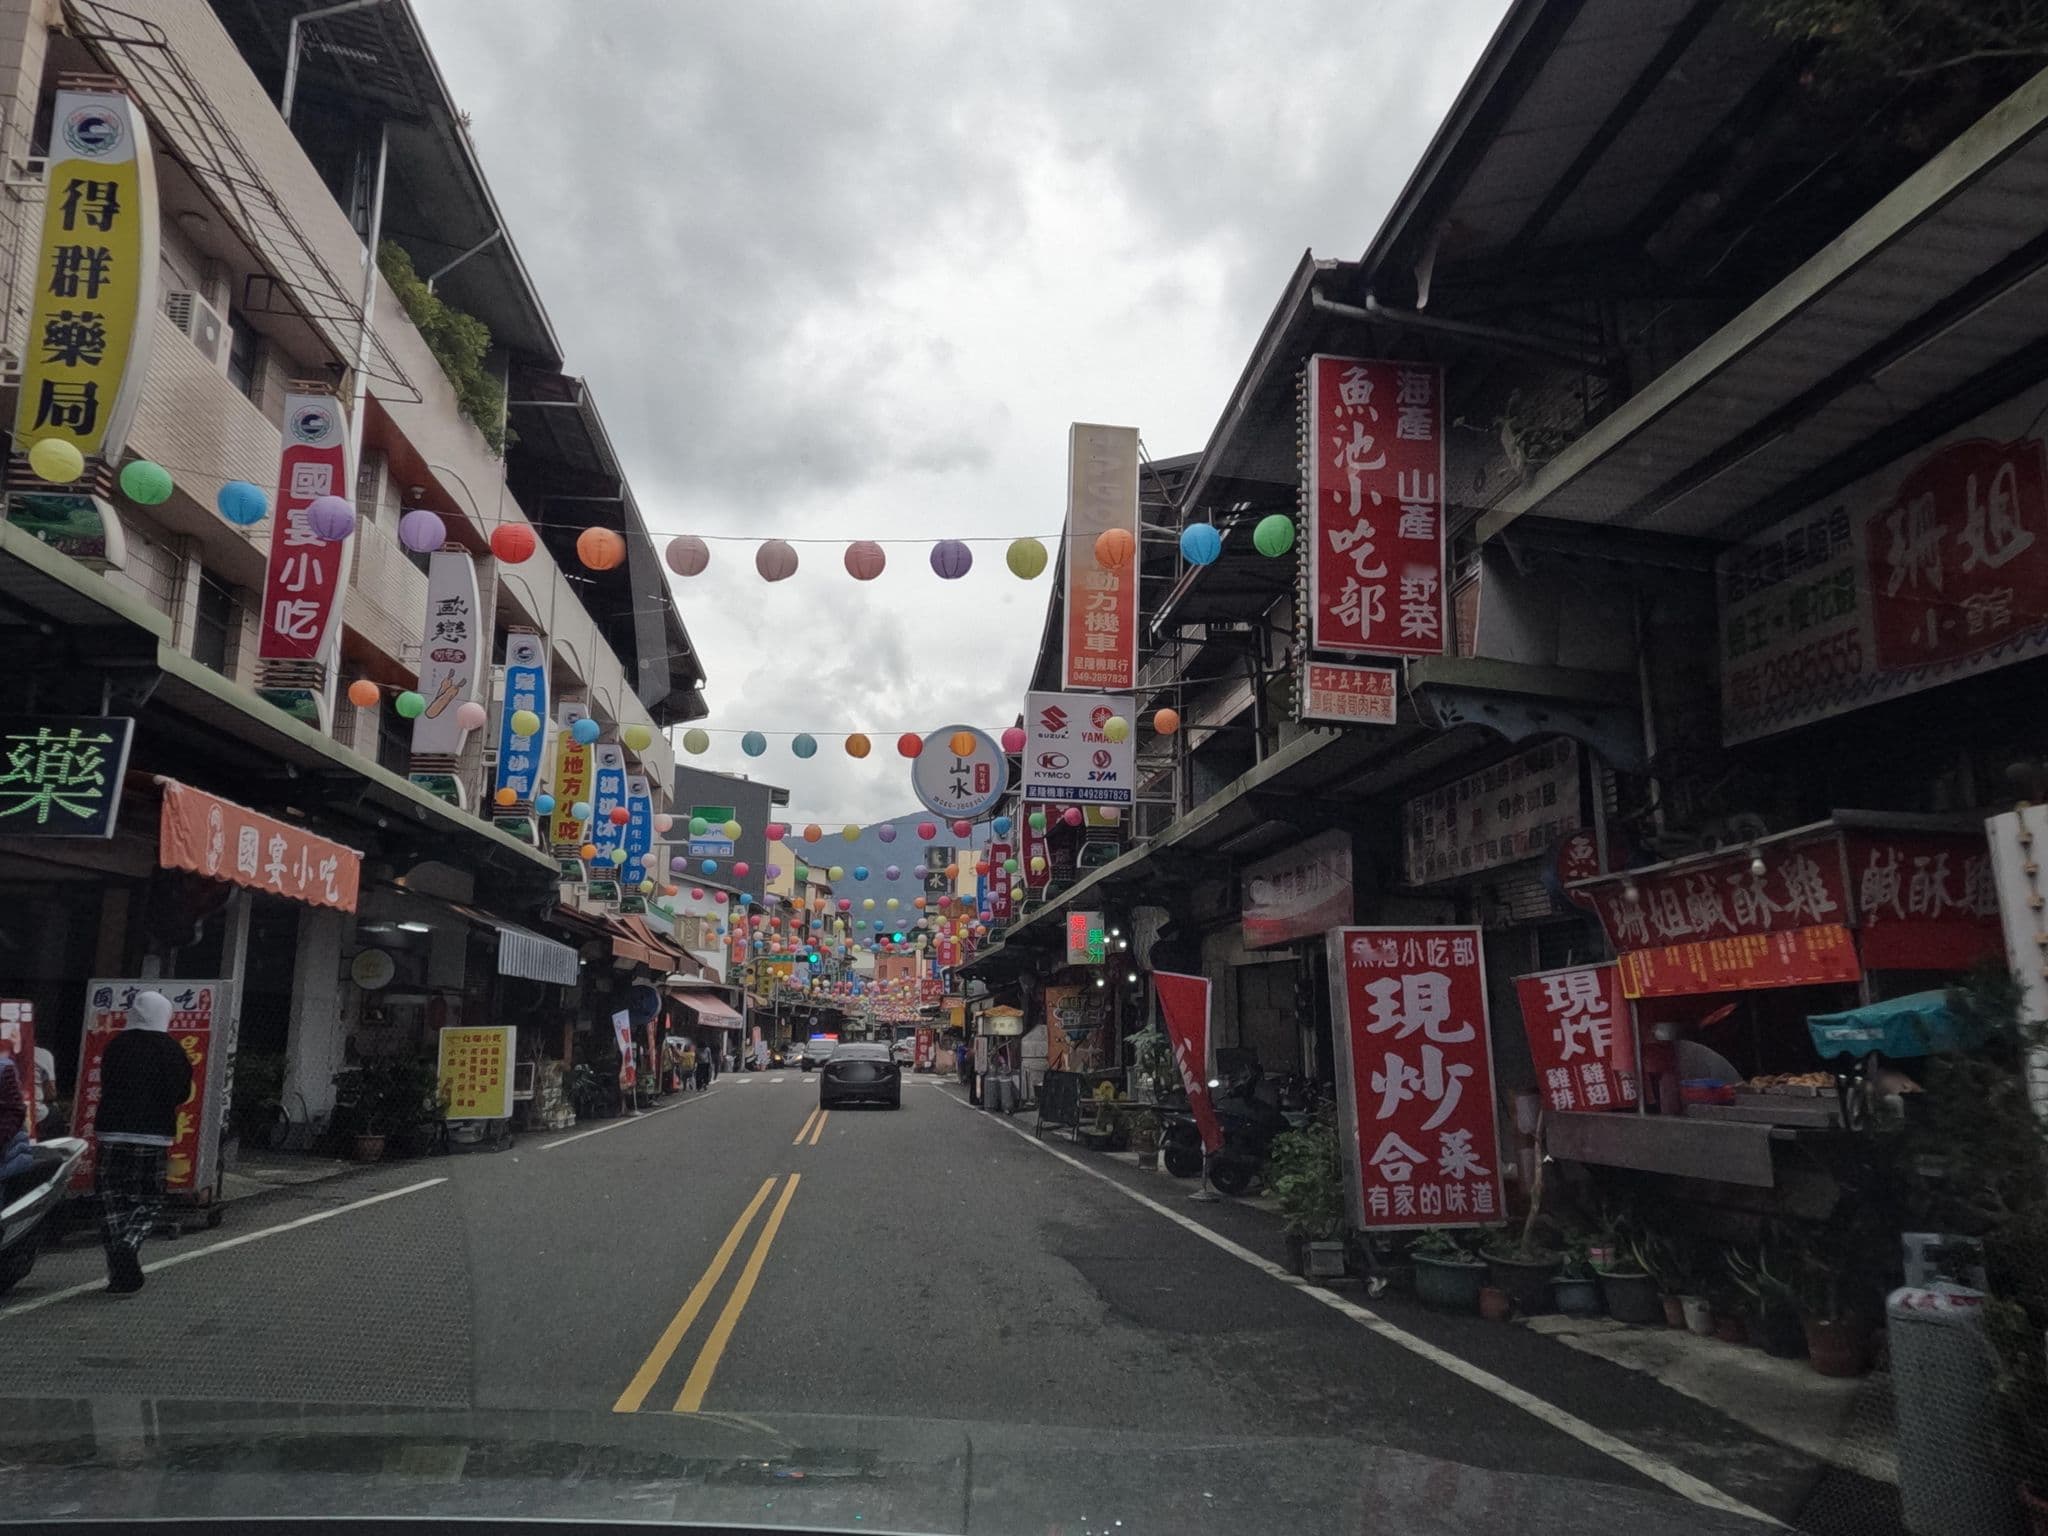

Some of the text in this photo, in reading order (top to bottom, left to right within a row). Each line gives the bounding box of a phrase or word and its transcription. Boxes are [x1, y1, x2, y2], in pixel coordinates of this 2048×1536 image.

[32, 177, 119, 437] 得群藥局
[1395, 371, 1434, 441] 海產
[1327, 366, 1388, 641] 魚池小吃部
[1398, 468, 1436, 541] 山產
[1311, 668, 1393, 693] 三十五年老店
[0, 727, 113, 824] 藥
[949, 757, 973, 799] 山水
[1035, 771, 1071, 780] KYMCO
[1078, 788, 1129, 801] 0492897826
[1088, 771, 1117, 781] SYM
[237, 825, 339, 901] 國宴小吃
[1540, 968, 1613, 1061] 現炸
[1364, 972, 1476, 1131] 現炒
[1546, 1067, 1576, 1111] 雞排
[1581, 1062, 1611, 1106] 雞翅
[1368, 1128, 1491, 1182] 合菜
[1368, 1182, 1495, 1217] 有家的味道
